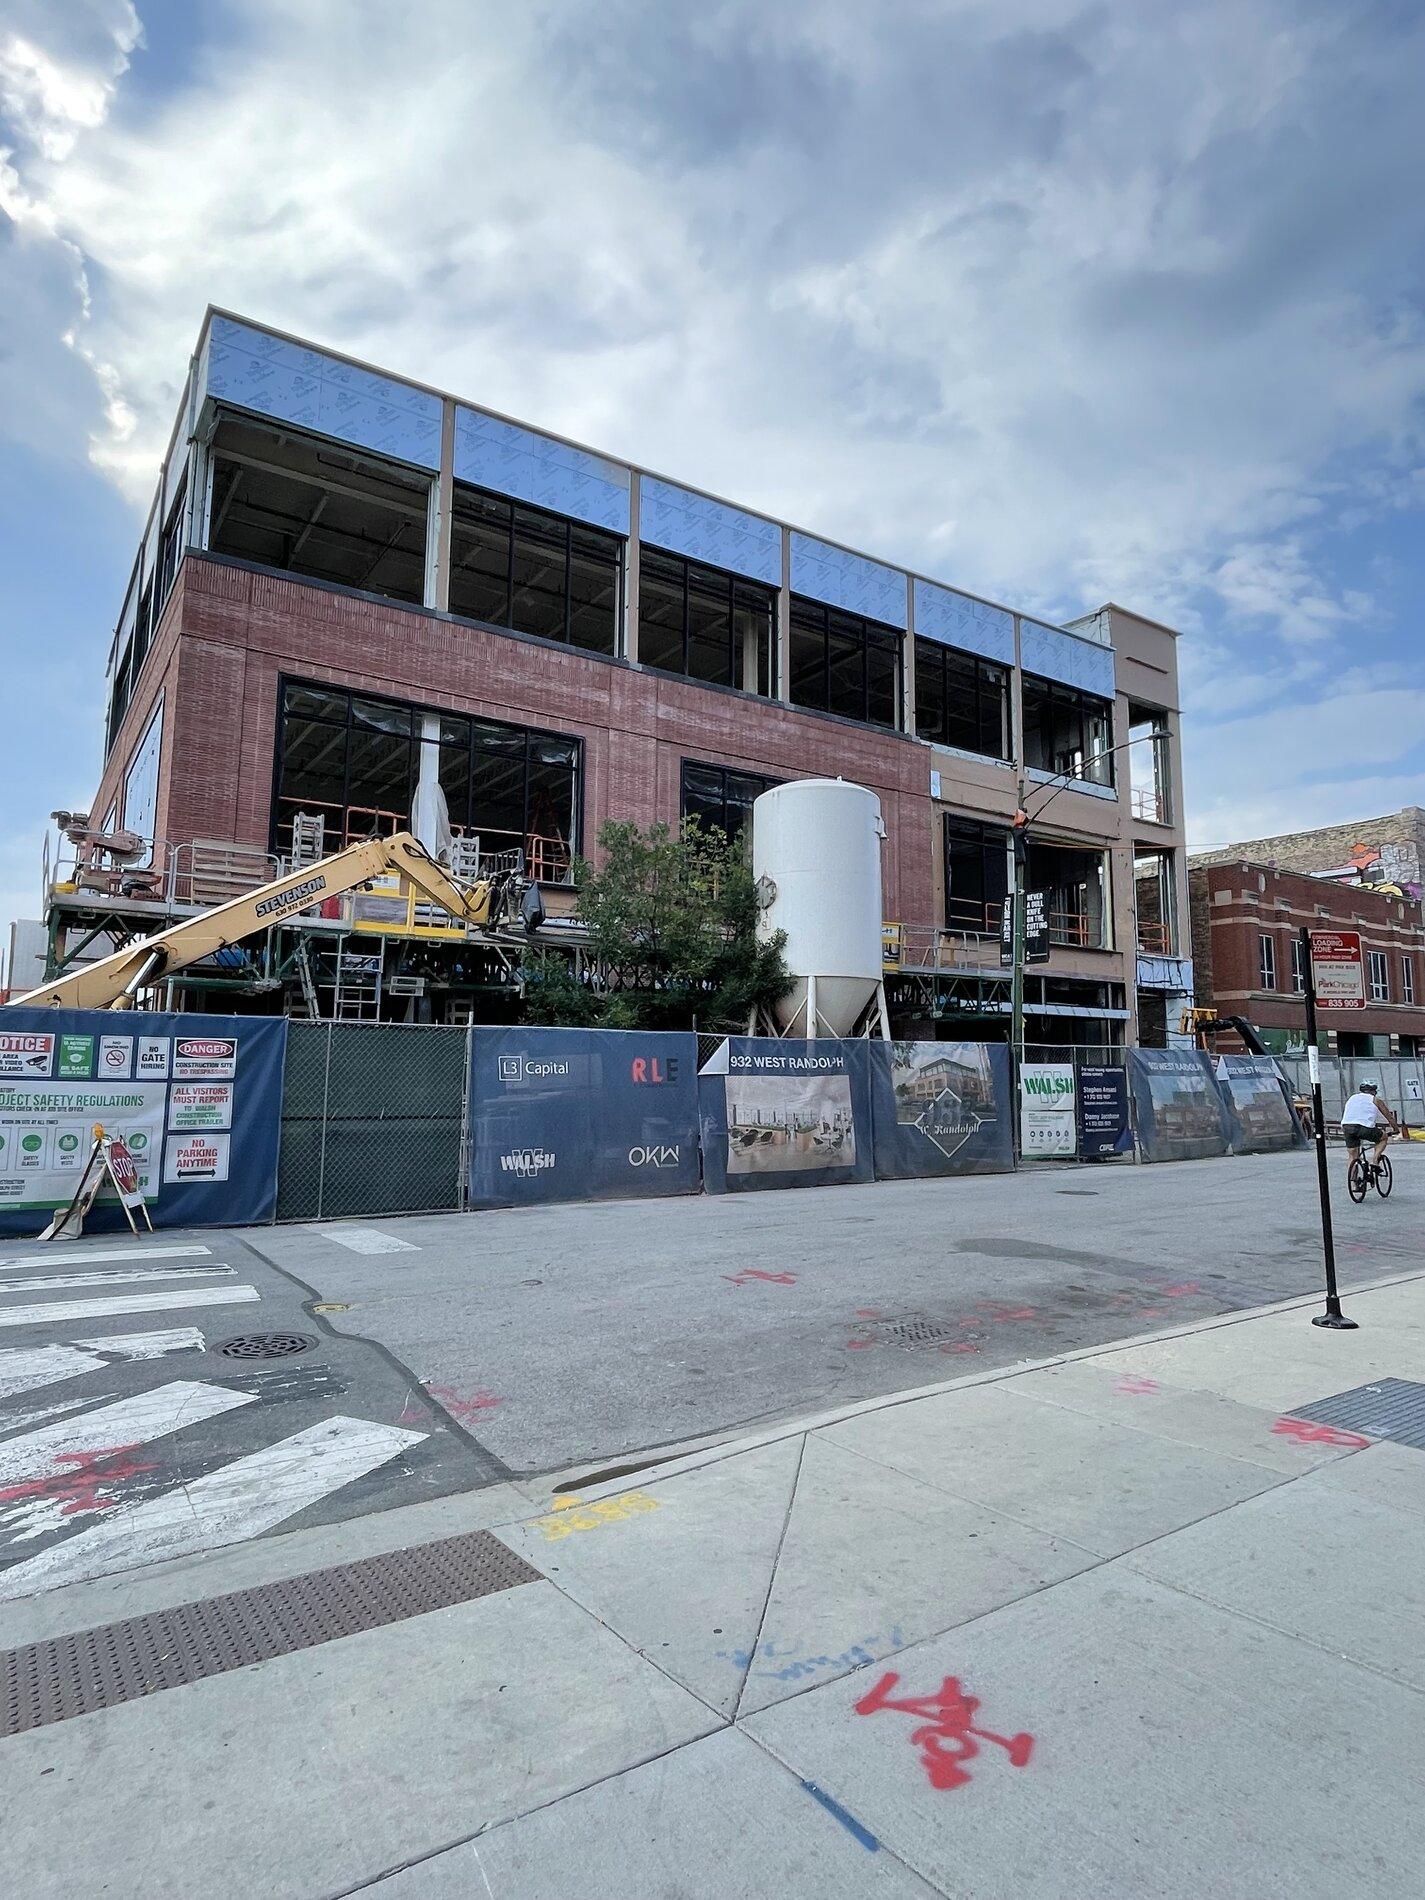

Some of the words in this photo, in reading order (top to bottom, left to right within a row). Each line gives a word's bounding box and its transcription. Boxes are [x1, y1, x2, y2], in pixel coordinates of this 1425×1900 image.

[256, 875, 326, 918] STEVENSON
[1026, 893, 1044, 902] NEVER
[1031, 900, 1044, 908] DULL
[1026, 908, 1042, 916] KNIFE
[1034, 914, 1044, 922] THE
[1026, 922, 1048, 931] CUTTING
[0, 1036, 46, 1051] OTICE
[184, 1045, 227, 1054] DANGER
[142, 1054, 165, 1062] GATE
[730, 1056, 752, 1068] 932
[754, 1057, 786, 1068] WEST
[788, 1057, 844, 1069] RANDOLPH
[503, 1062, 518, 1074] L3
[525, 1062, 569, 1077] Capital
[632, 1057, 679, 1083] RLE
[1024, 1078, 1074, 1094] WALSH
[1412, 1087, 1418, 1098] 1
[0, 1094, 31, 1106] OJECT
[33, 1094, 74, 1106] SAFETY
[76, 1094, 144, 1107] REGULATIONS
[934, 1124, 980, 1136] Randolph
[192, 1139, 204, 1148] NO
[177, 1148, 218, 1158] PARKING
[628, 1146, 680, 1168] OKW
[176, 1158, 218, 1168] ANYTIME
[500, 1153, 556, 1171] WALSH
[113, 1158, 134, 1178] STOP
